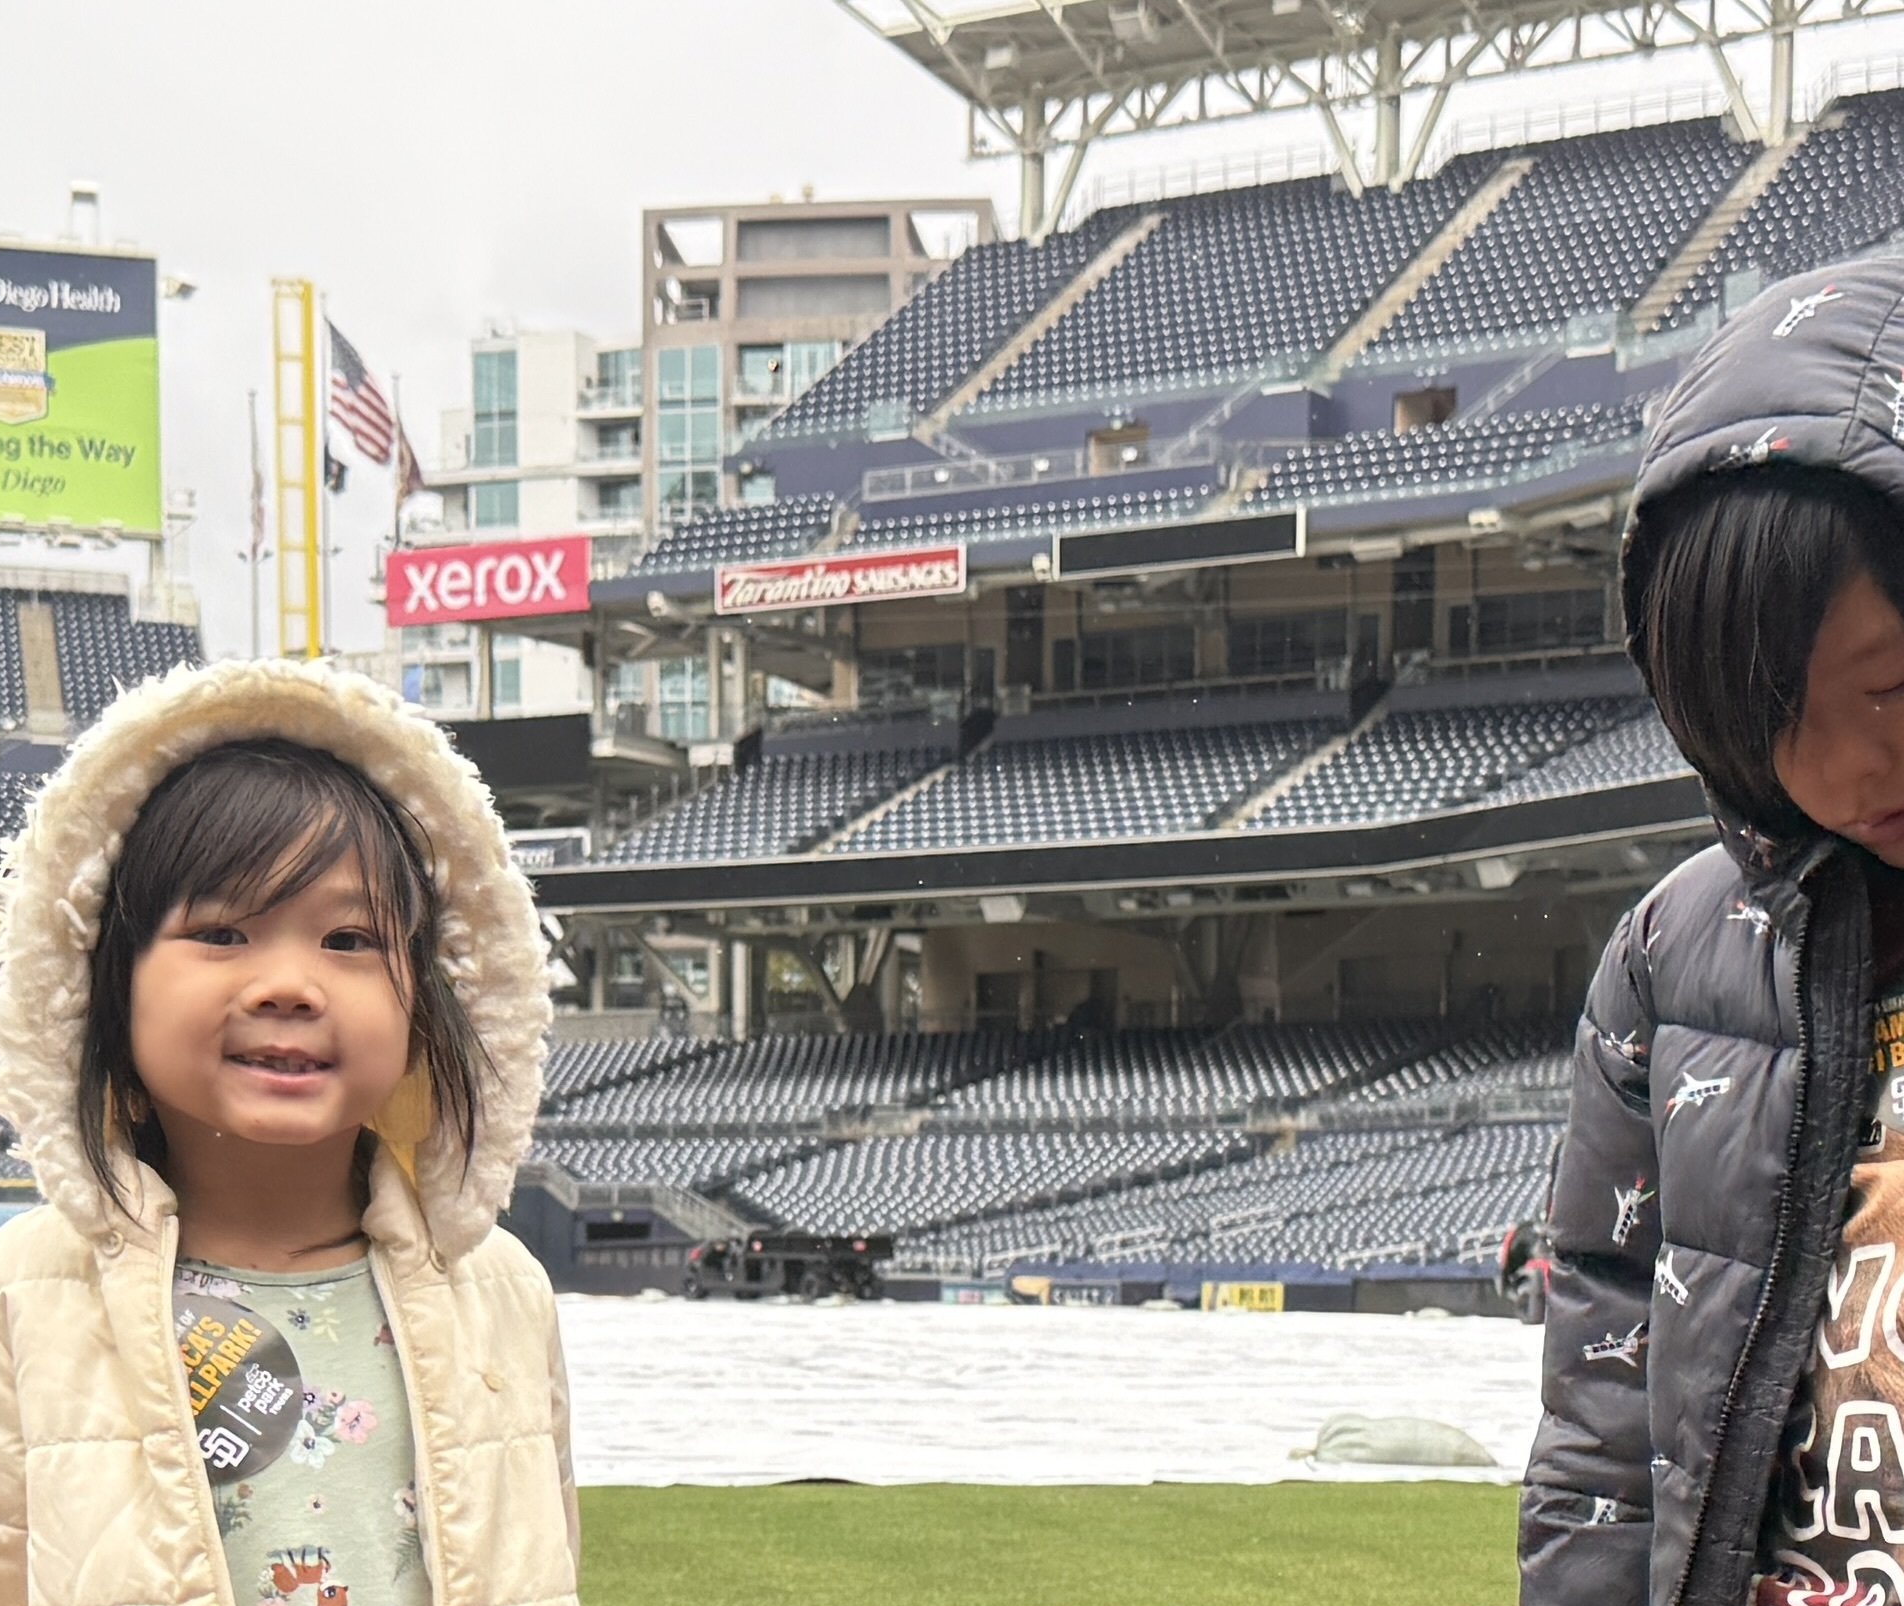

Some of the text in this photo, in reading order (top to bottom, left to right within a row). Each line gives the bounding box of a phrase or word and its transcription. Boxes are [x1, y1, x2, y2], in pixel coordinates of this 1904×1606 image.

[48, 279, 121, 313] Health
[28, 433, 71, 460] the
[77, 436, 135, 468] Way
[2, 468, 66, 496] Diego
[403, 549, 567, 613] xerox
[724, 564, 852, 607] Tarantino
[181, 1316, 226, 1374] CA'S
[254, 1377, 285, 1415] park
